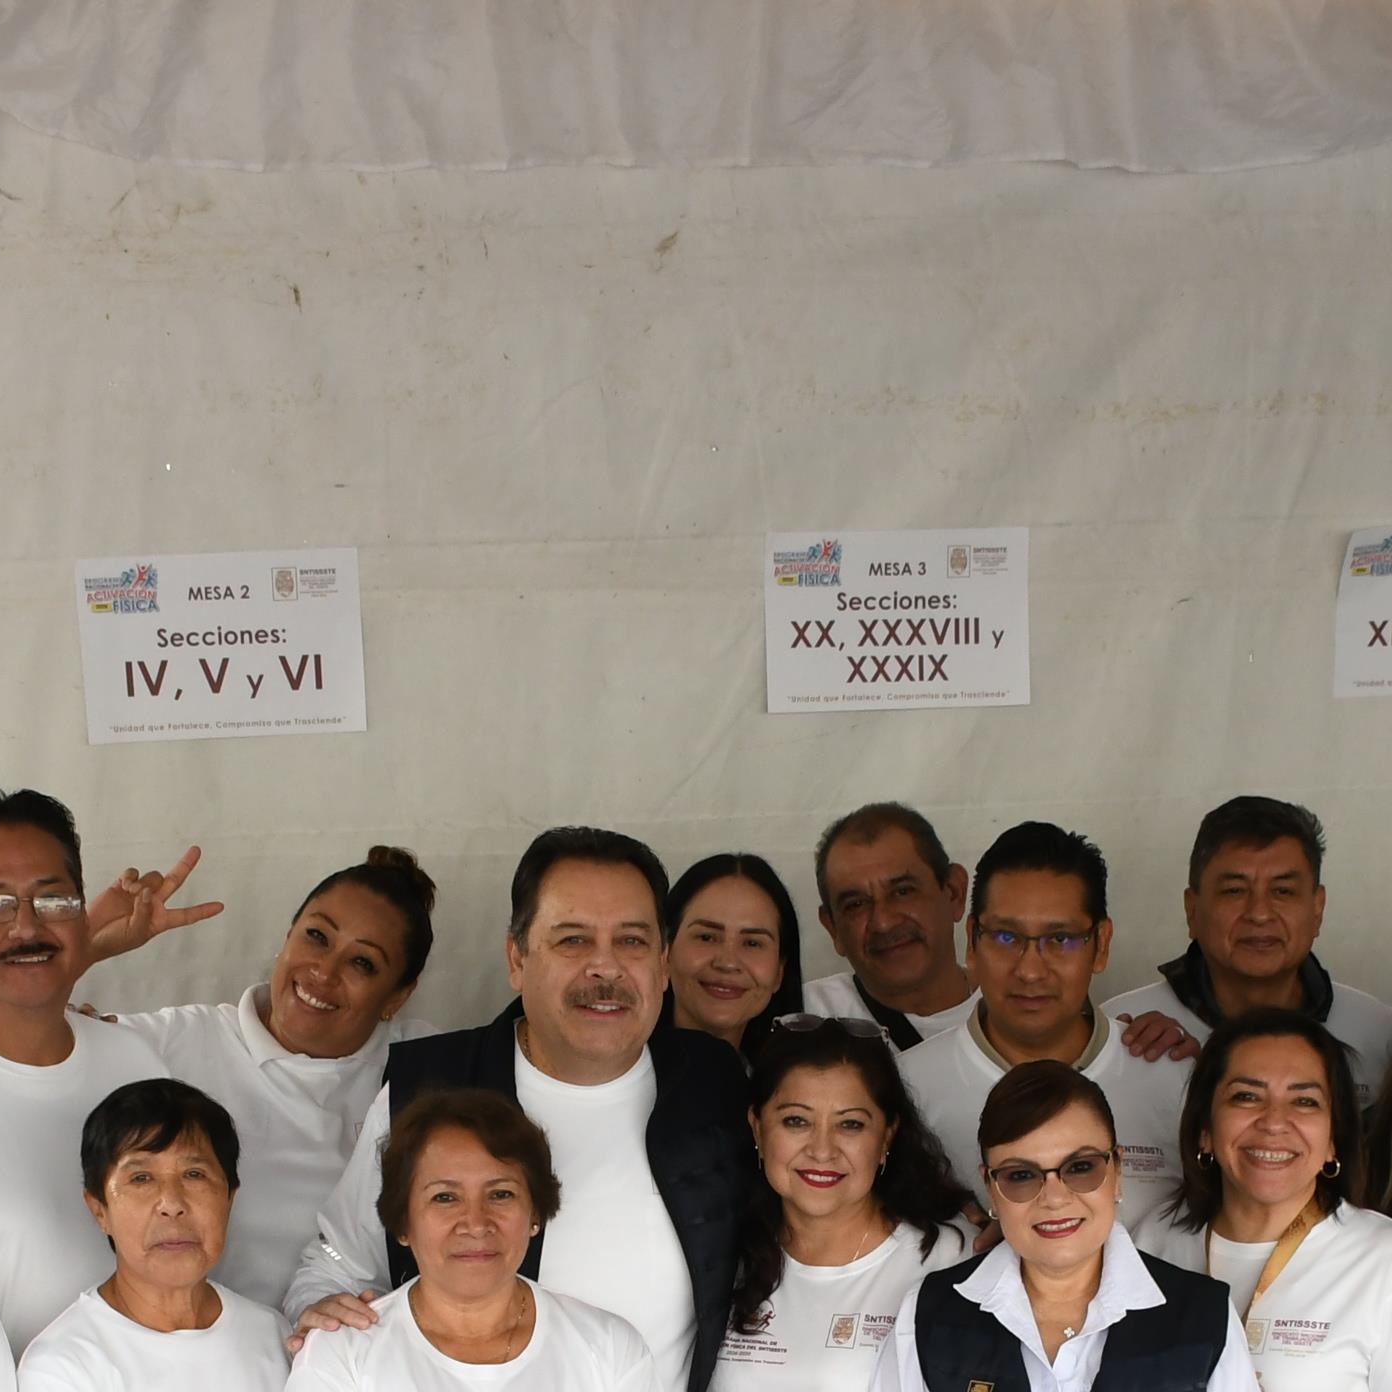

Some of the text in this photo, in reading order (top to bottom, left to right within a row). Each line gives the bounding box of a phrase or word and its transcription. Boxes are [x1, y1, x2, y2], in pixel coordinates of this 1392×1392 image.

[869, 562, 927, 576] MESA 3
[188, 585, 250, 601] MESA 2
[837, 591, 957, 611] Secciones:
[157, 626, 287, 648] Secciones:
[790, 617, 1005, 651] XX, XXXVIII y
[124, 654, 322, 701] IV, V y VI
[846, 654, 949, 683] XXXIX
[1274, 1320, 1332, 1329] SNTISSSTE
